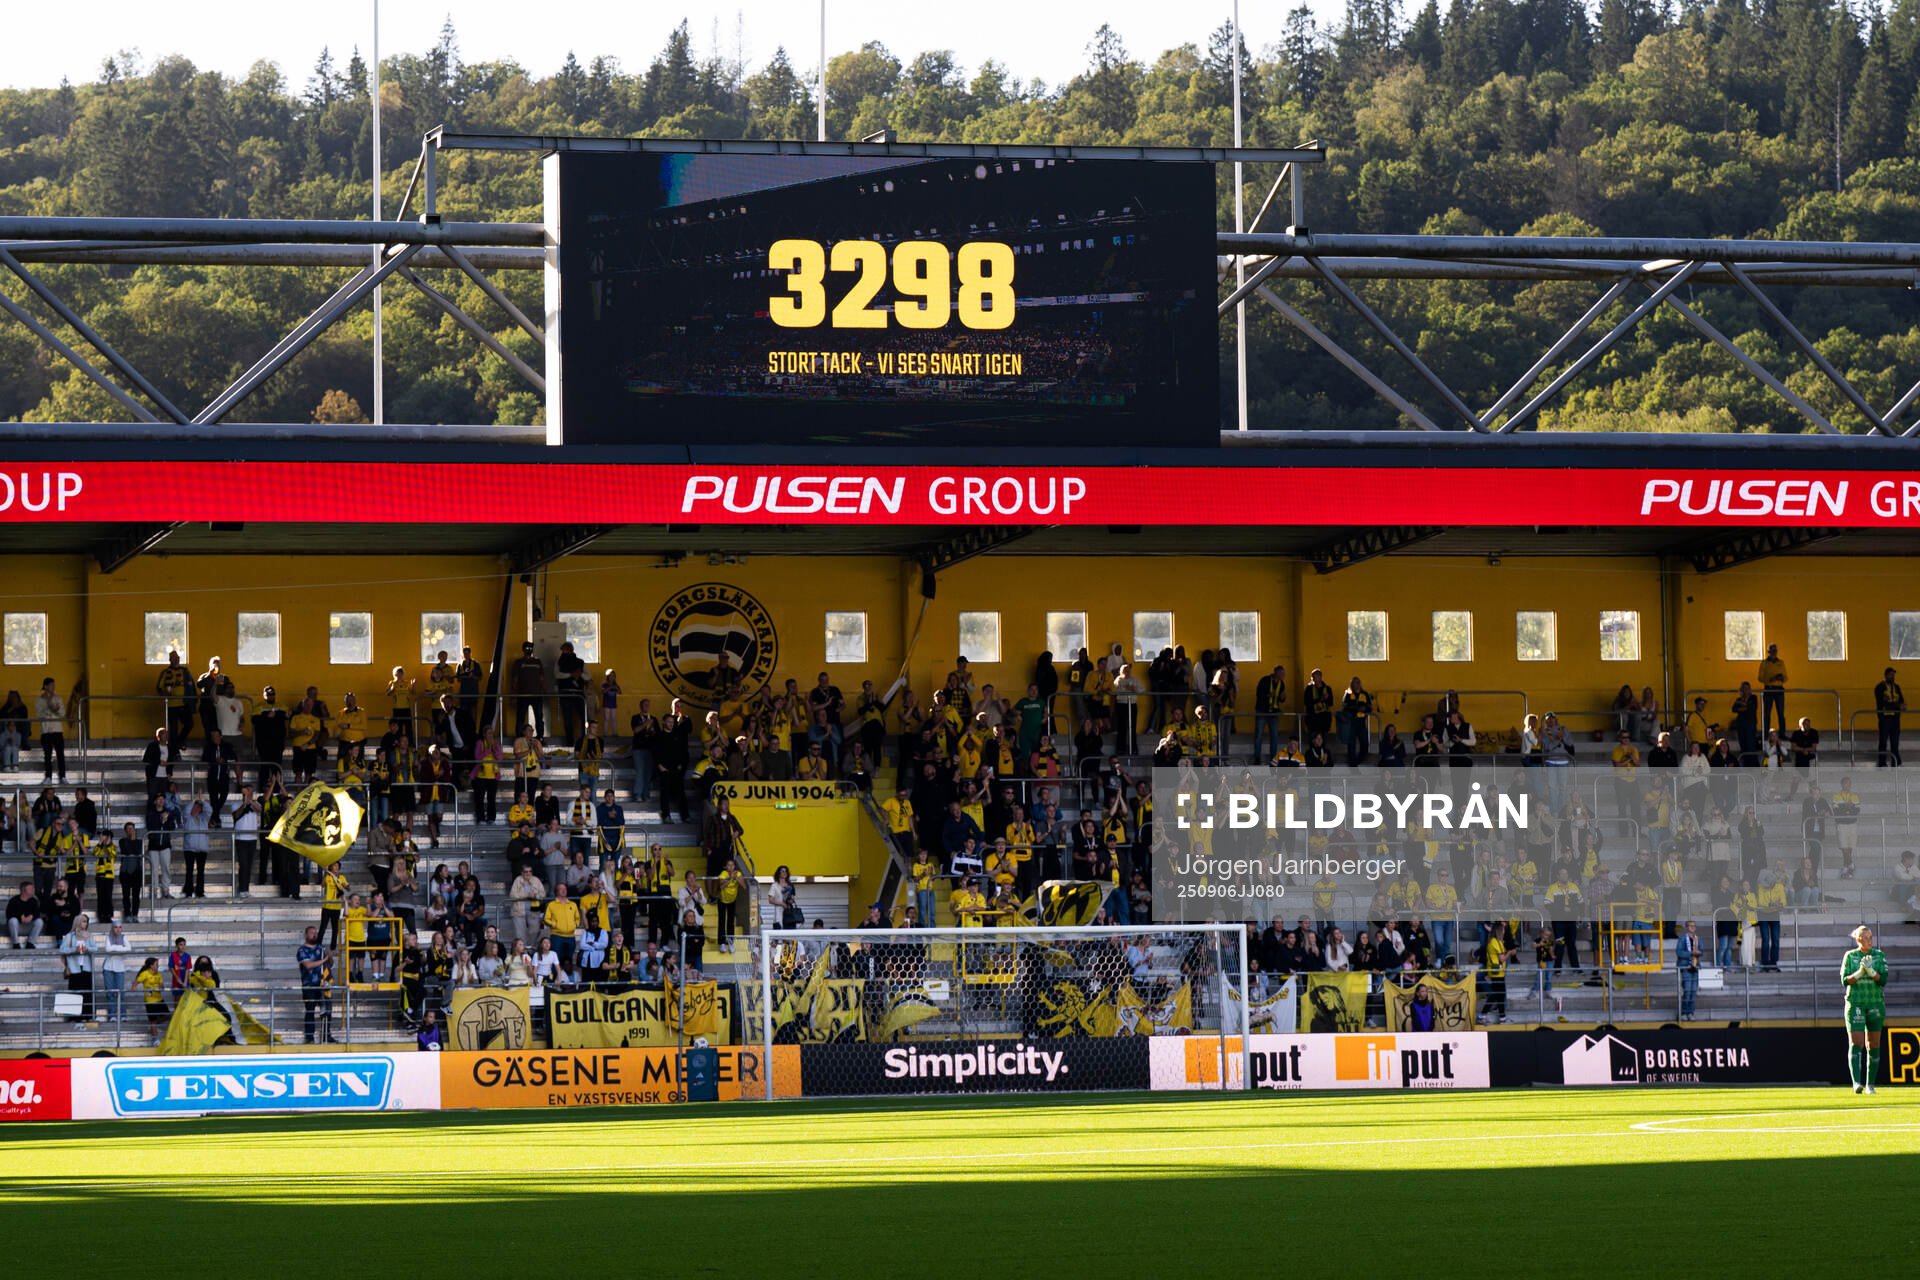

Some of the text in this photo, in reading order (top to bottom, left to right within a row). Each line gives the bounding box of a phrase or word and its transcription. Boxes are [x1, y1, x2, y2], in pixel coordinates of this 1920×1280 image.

[769, 239, 1016, 330] 3298
[768, 351, 818, 374] STORT
[821, 352, 861, 374] TACK
[878, 353, 893, 375] VI
[898, 354, 927, 375] SES
[931, 354, 982, 375] SNART
[985, 354, 1022, 376] IGEN
[681, 476, 1087, 515] PULSEN GROUP
[1640, 479, 1849, 516] PULSEN
[653, 586, 774, 685] ELFSBORGSLÄKTAREN
[744, 786, 786, 799] JUNI
[791, 786, 834, 799] 1904
[629, 1027, 649, 1039] 1991
[472, 1055, 621, 1088] GÄSENE
[885, 1043, 1069, 1083] Simplicity.
[1368, 1043, 1455, 1087] input
[1645, 1048, 1750, 1068] BORGSTENA
[125, 1072, 375, 1102] JENSEN
[548, 1094, 566, 1105] EN
[573, 1091, 661, 1105] VÄSTSVENSK
